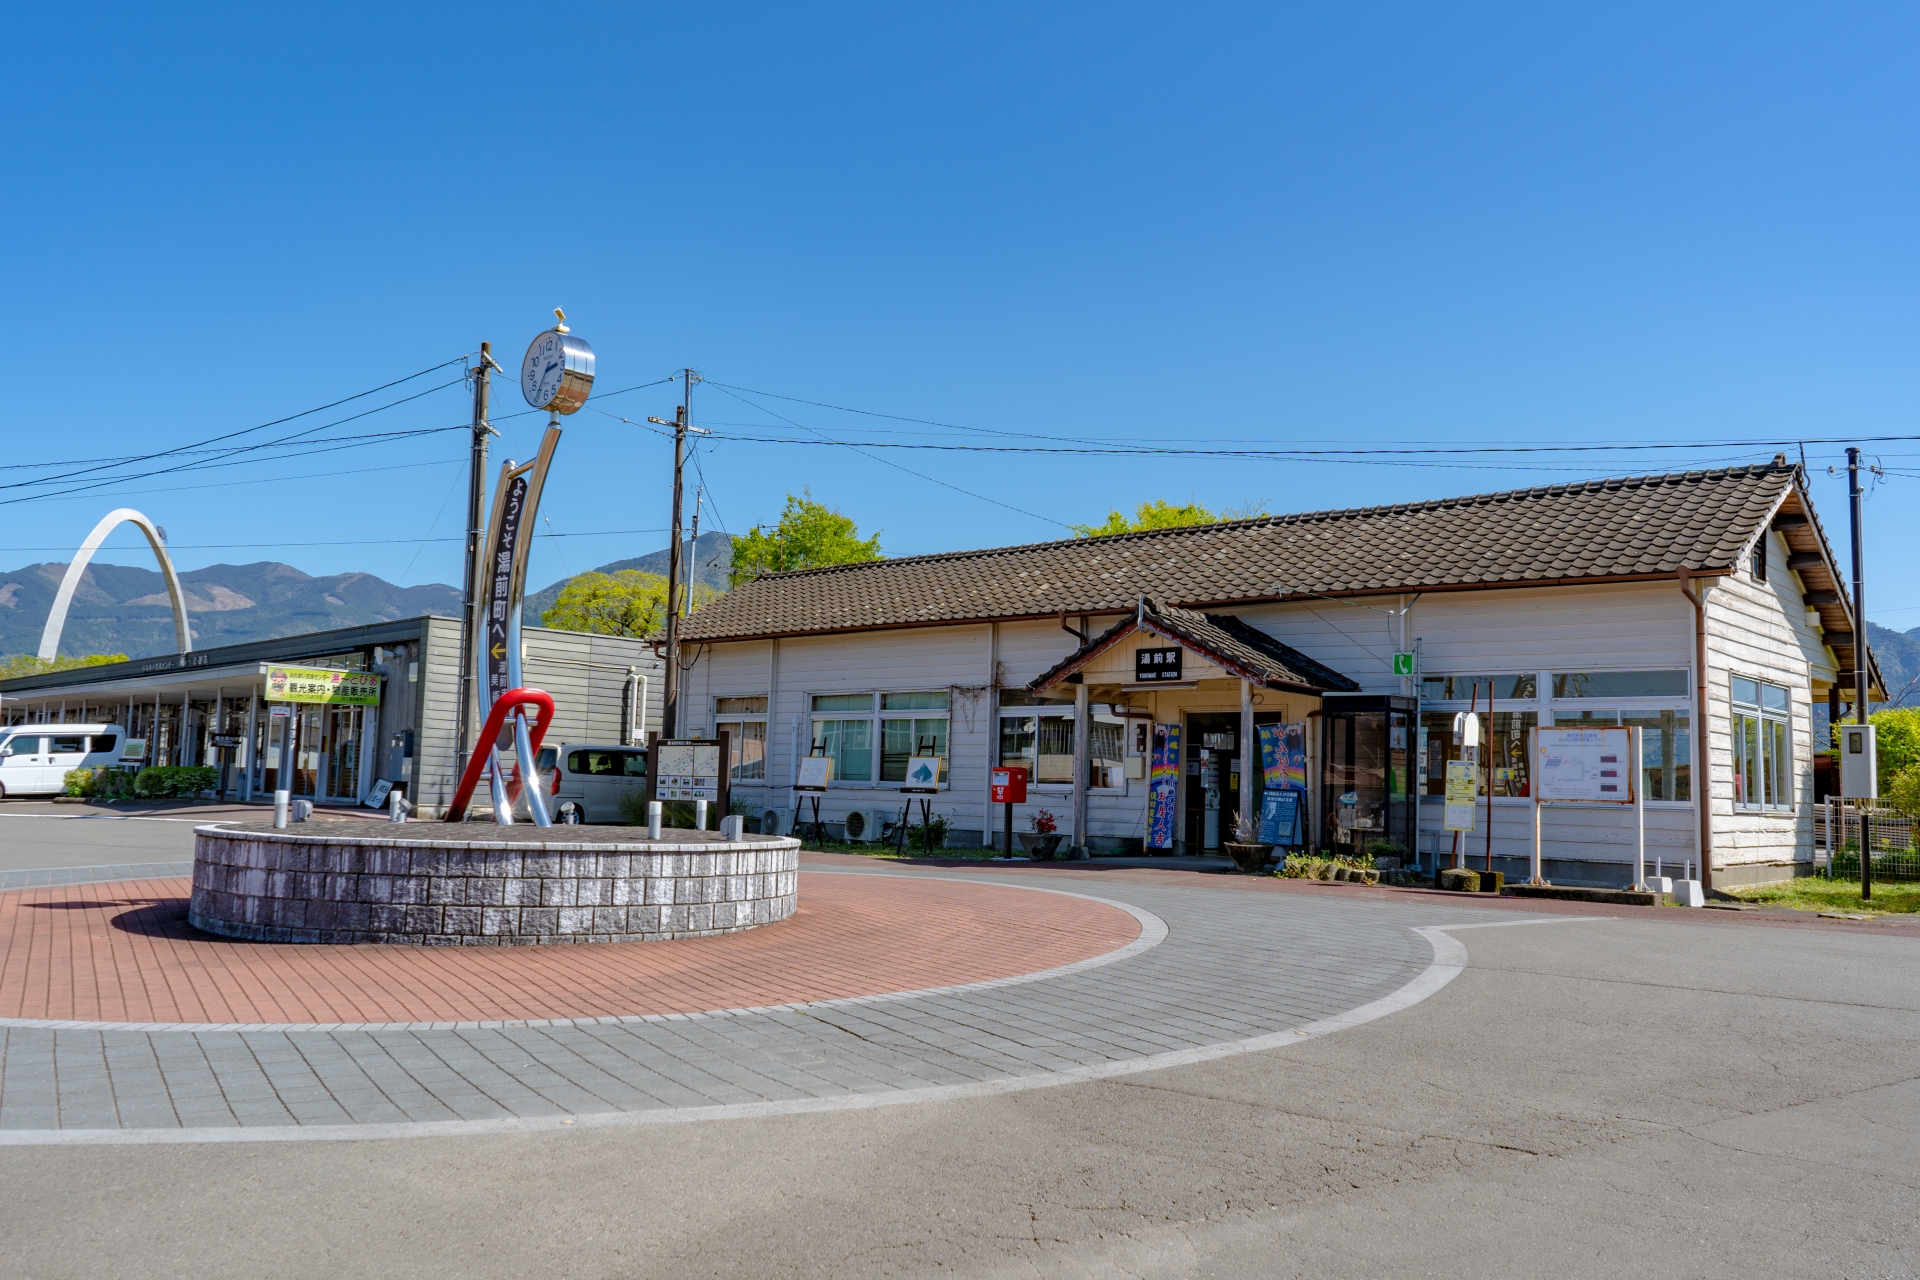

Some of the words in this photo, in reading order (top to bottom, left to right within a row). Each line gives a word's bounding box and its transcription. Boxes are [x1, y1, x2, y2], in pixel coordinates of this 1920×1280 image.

[539, 344, 544, 356] 11
[546, 340, 552, 351] 12
[559, 348, 564, 358] 2
[532, 356, 540, 368] 10
[560, 360, 564, 371] 3
[530, 370, 535, 380] 9
[557, 373, 562, 382] 4
[532, 381, 537, 391] 8
[551, 385, 556, 396] 5
[544, 390, 548, 400] 6
[492, 480, 523, 638] ようこそ湯前町へ
[1141, 651, 1176, 665] 湯前駅
